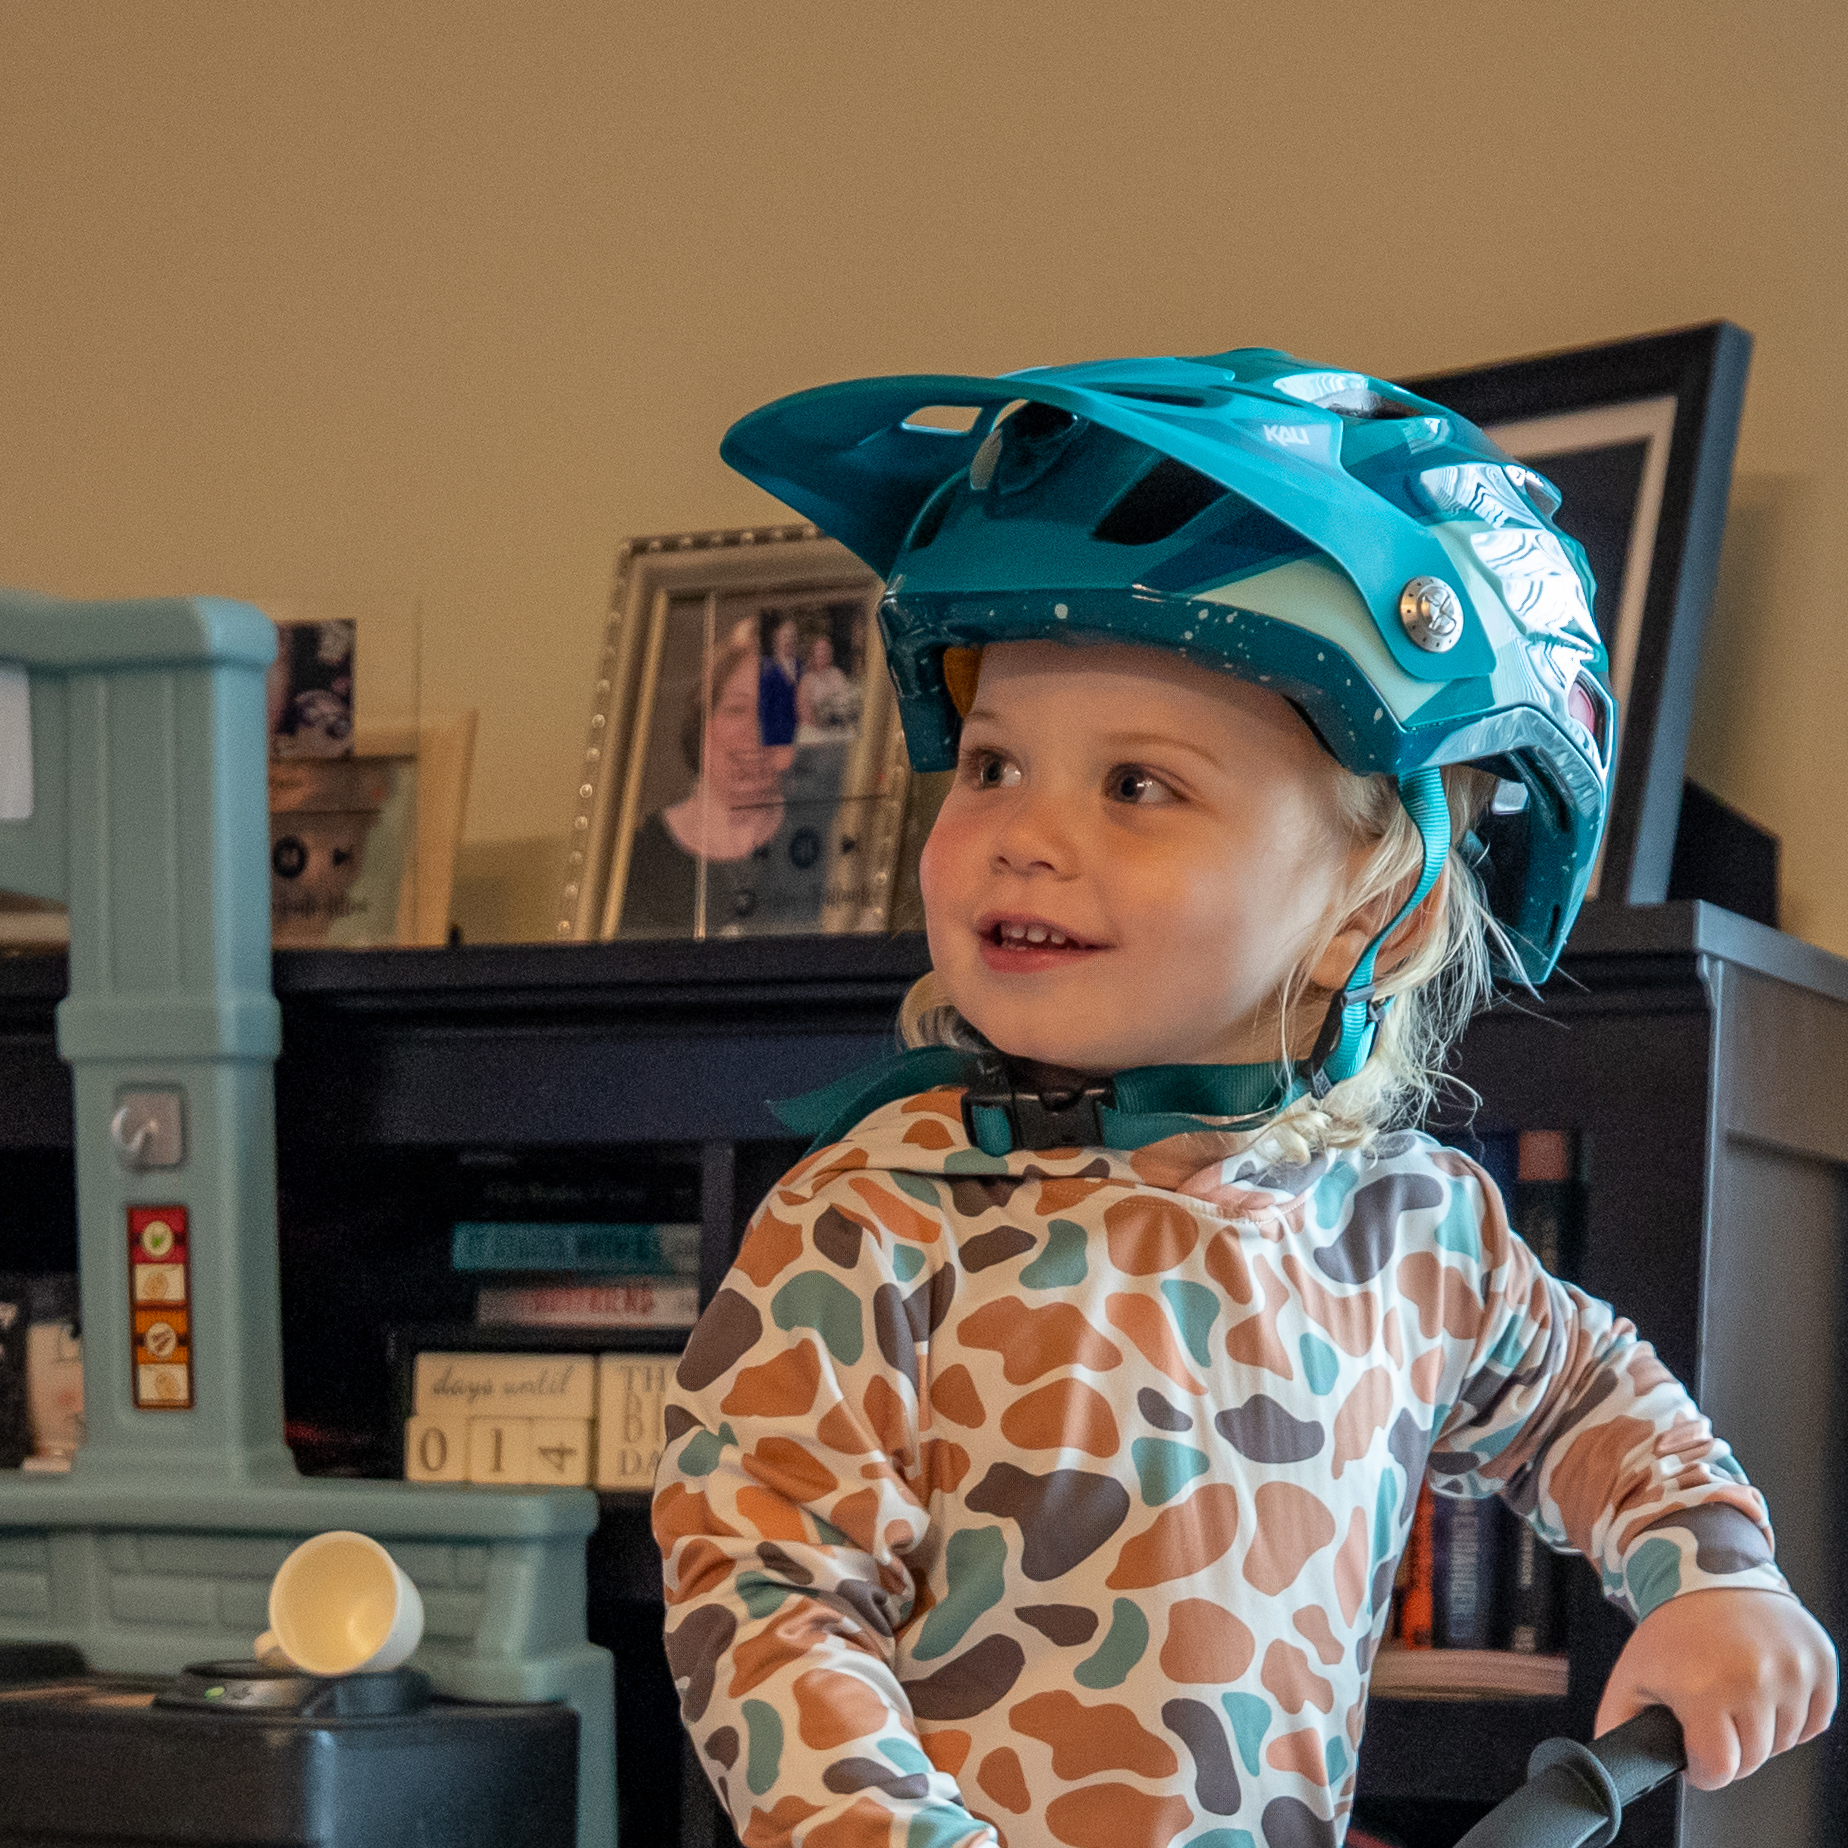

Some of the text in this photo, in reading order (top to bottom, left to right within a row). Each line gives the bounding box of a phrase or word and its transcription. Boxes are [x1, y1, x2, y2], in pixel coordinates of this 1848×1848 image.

[1262, 424, 1311, 447] KALI
[432, 1364, 575, 1404] days until
[625, 1392, 662, 1443] BI
[618, 1448, 664, 1476] DA
